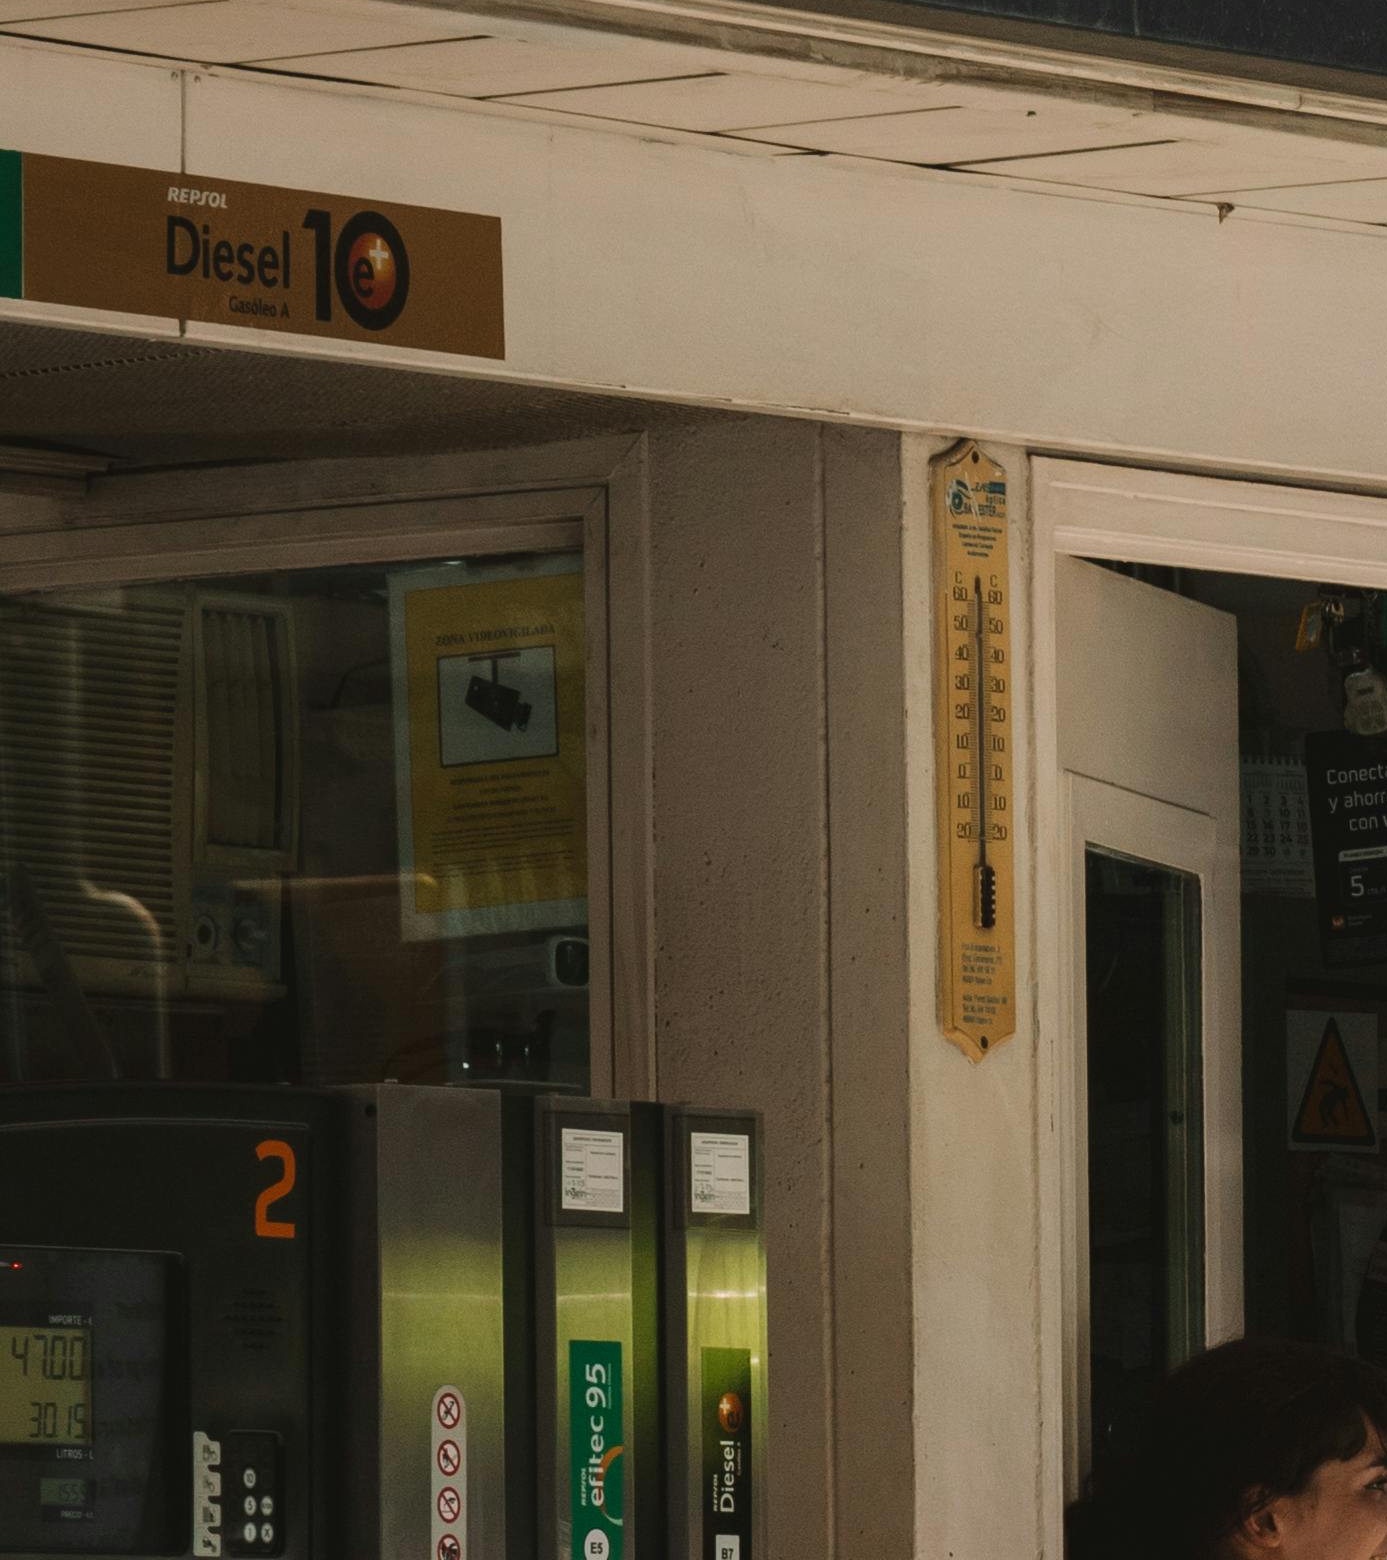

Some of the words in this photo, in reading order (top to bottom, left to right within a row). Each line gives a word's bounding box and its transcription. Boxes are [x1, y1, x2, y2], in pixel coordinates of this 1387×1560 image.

[167, 187, 228, 209] REPSOL
[166, 215, 290, 290] Diesel
[302, 209, 410, 331] 10
[228, 295, 278, 318] Gasóleo
[279, 303, 290, 320] A
[953, 586, 967, 601] 60
[988, 590, 1002, 605] 60
[954, 615, 968, 631] 50
[989, 618, 1003, 634] 50
[955, 644, 969, 661] 40
[990, 648, 1004, 664] 40
[955, 675, 969, 690] 30
[990, 678, 1005, 693] 30
[955, 704, 969, 719] 20
[991, 706, 1006, 722] 20
[956, 734, 968, 749] 10
[992, 737, 1005, 752] 10
[958, 763, 966, 779] 0
[994, 765, 1002, 781] 0
[957, 793, 969, 808] 10
[994, 796, 1006, 811] 10
[1328, 797, 1339, 814] y
[956, 822, 971, 838] 20
[992, 824, 1007, 840] 20
[1349, 815, 1379, 832] con
[1350, 875, 1365, 898] 5
[255, 1140, 297, 1239] 2
[585, 1362, 607, 1409] 95
[588, 1414, 605, 1507] efitec
[719, 1440, 735, 1513] Diesel
[590, 1542, 603, 1555] E5
[721, 1548, 734, 1560] B7
